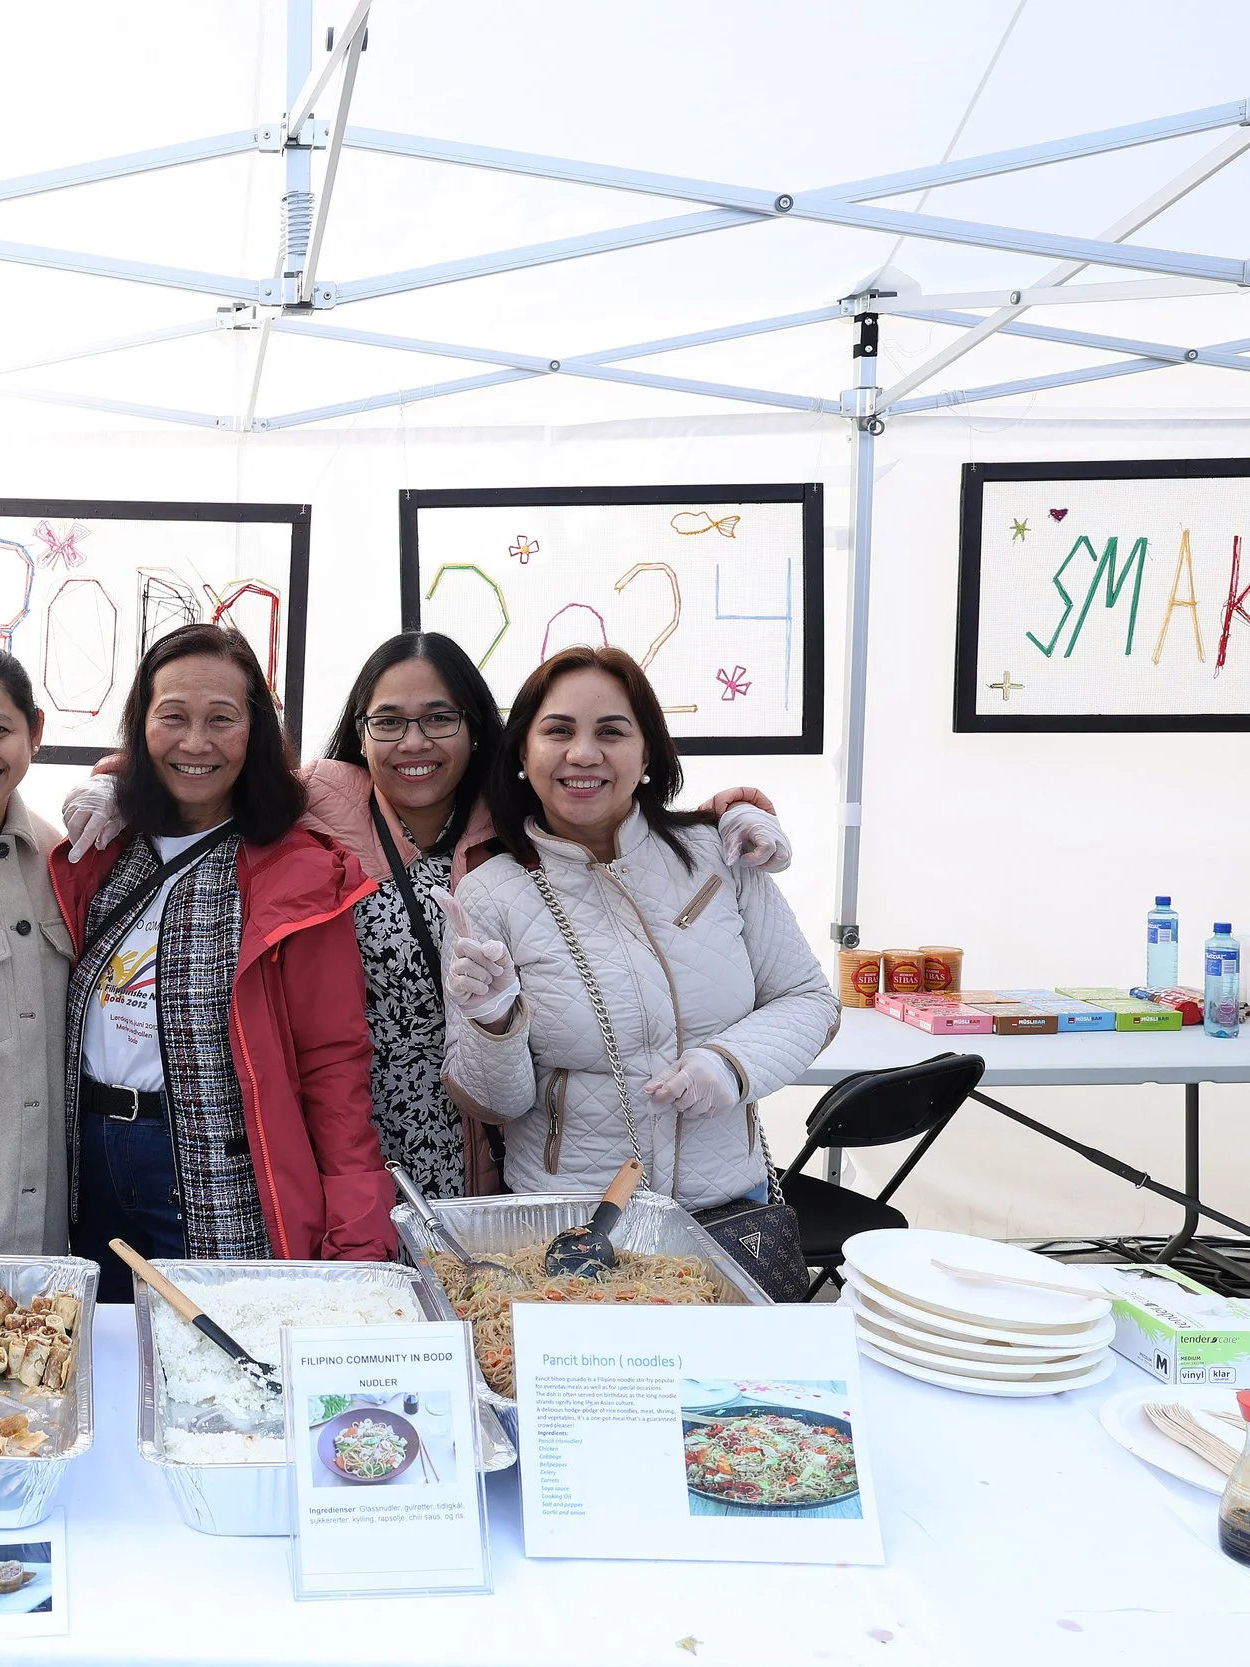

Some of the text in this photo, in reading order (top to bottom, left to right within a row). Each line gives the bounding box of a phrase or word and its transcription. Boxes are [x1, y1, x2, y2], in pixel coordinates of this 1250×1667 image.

[893, 976, 919, 984] SIBAS
[925, 973, 946, 982] IBAS
[126, 999, 148, 1009] 2012
[1180, 1335, 1210, 1343] tender
[301, 1352, 453, 1366] FILIPINO COMMUNITY IN BODØ
[542, 1354, 578, 1366] Pancit
[581, 1354, 616, 1367] bihon
[627, 1355, 675, 1368] noodles
[1156, 1353, 1168, 1375] M
[1182, 1371, 1204, 1380] vinyl
[359, 1378, 398, 1388] NUDLER
[603, 1391, 628, 1399] birthdays
[646, 1392, 657, 1400] long
[359, 1504, 402, 1513] Glassnudler,
[408, 1513, 423, 1521] chili
[444, 1512, 454, 1521] og
